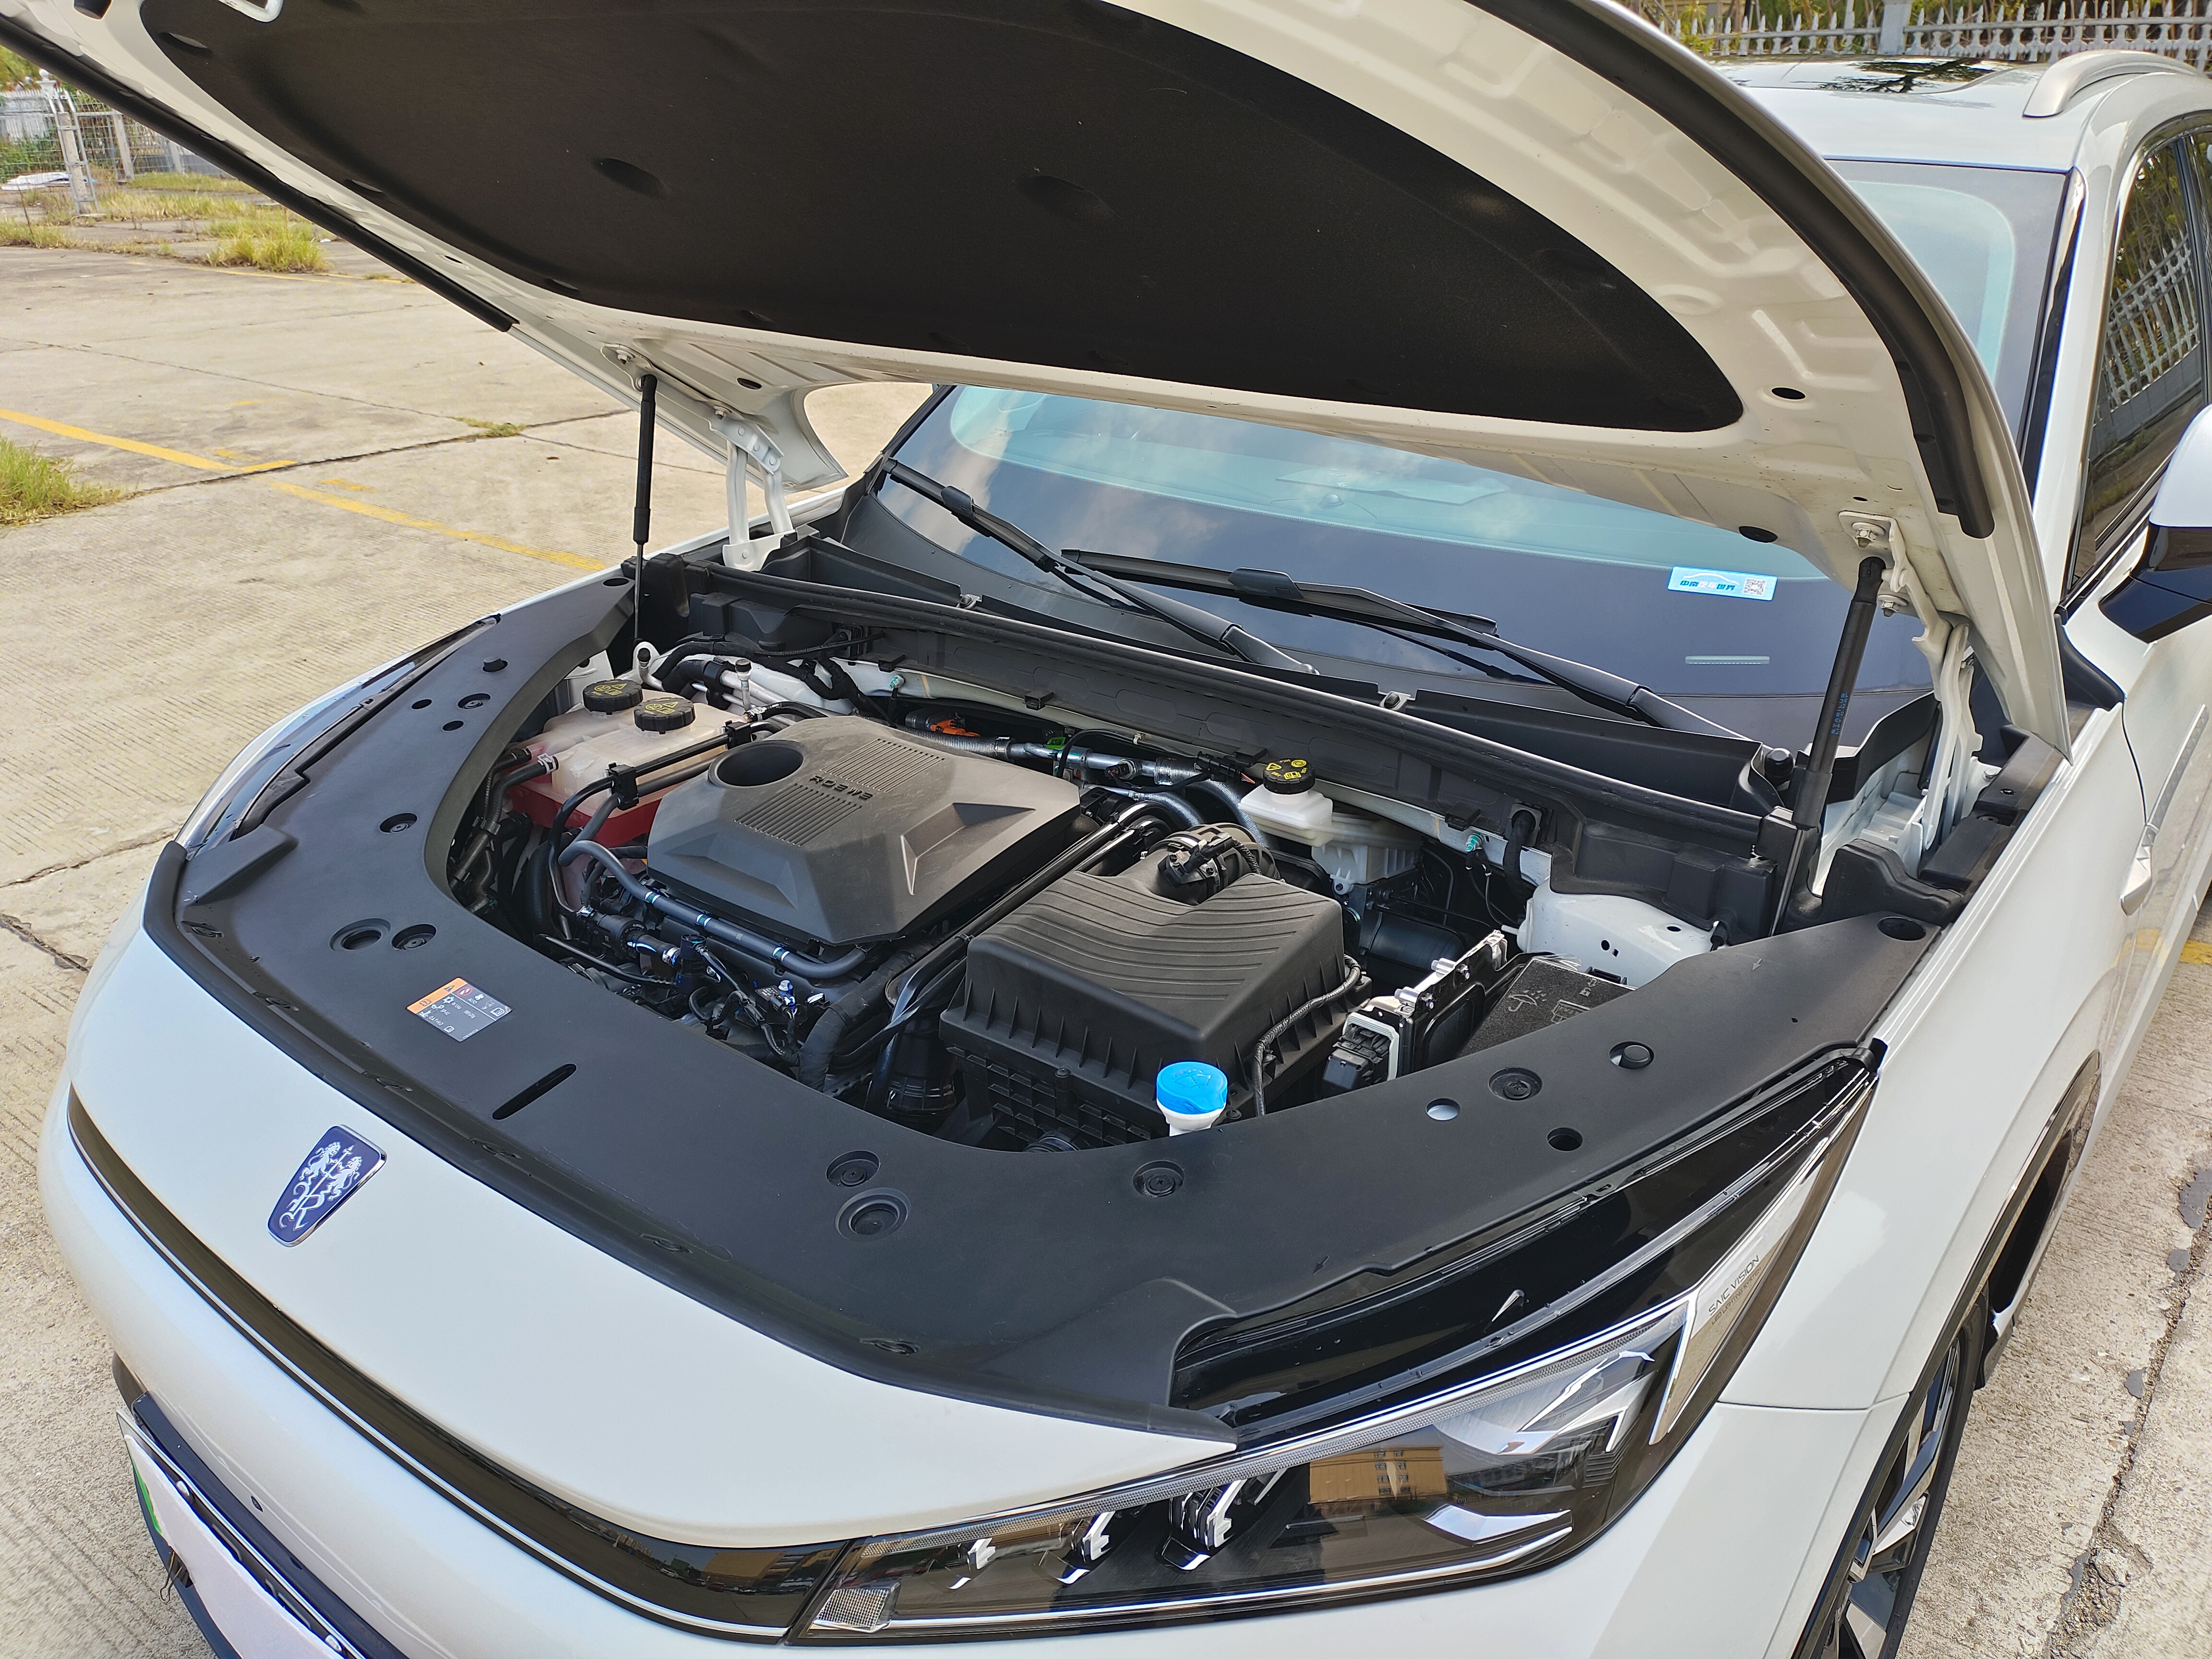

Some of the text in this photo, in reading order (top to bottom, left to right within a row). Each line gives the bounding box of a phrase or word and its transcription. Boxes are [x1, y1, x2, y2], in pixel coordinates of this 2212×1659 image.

[1831, 693, 1845, 734] STABILUS
[809, 775, 874, 800] ROEWE
[1708, 1255, 1759, 1316] SAIC VISION
[1712, 1267, 1761, 1325] LED LIGHTING SYSTEM
